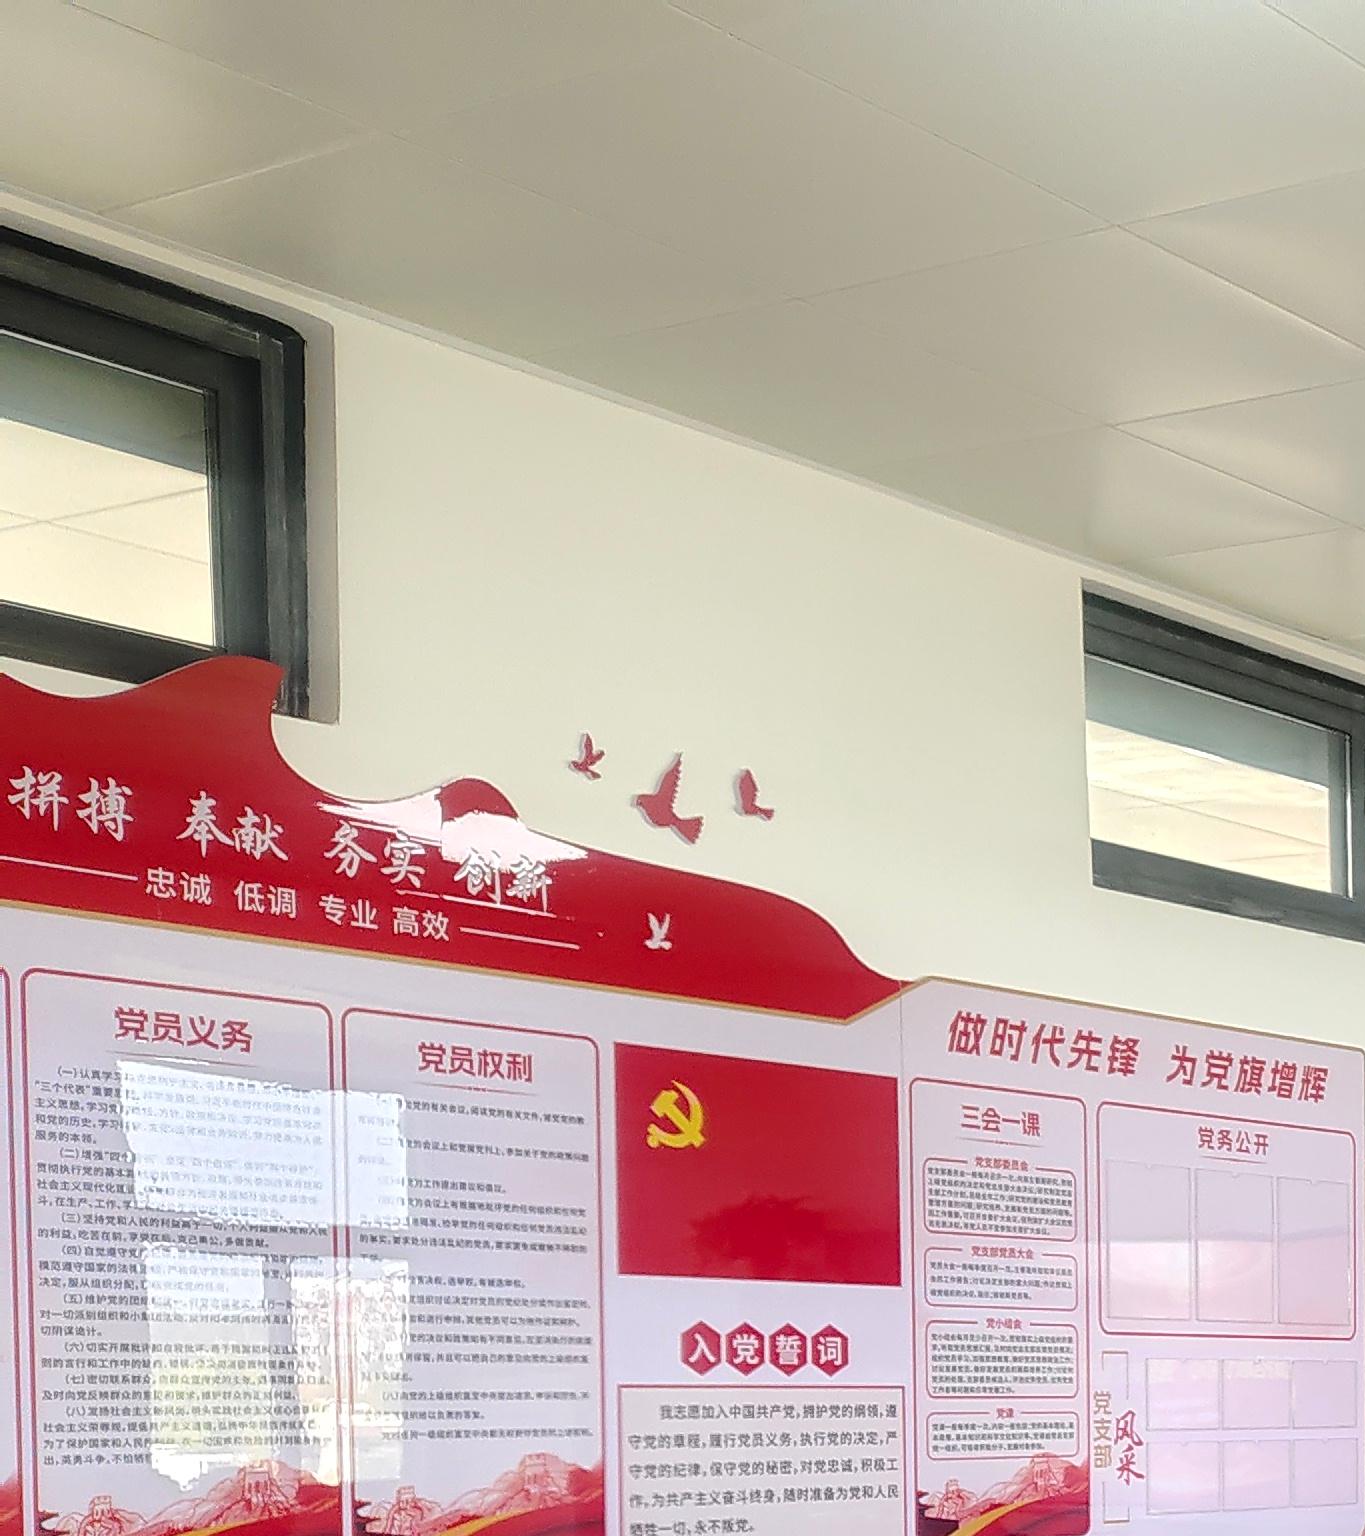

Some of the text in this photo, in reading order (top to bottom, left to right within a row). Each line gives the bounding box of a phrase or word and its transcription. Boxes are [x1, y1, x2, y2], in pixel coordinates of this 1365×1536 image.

[8, 765, 554, 912] 拼搏 奉献 务实 创新
[144, 866, 451, 943] 忠诚 低调 专业 高效
[113, 1006, 253, 1053] 党员义务
[946, 1009, 1330, 1104] 做时代先锋 为党旗增辉
[417, 1041, 534, 1083] 党员权利
[960, 1105, 1041, 1138] 三会一课
[1197, 1126, 1270, 1156] 党务公开
[687, 1332, 843, 1367] 入党誓词
[1093, 1390, 1113, 1469] 党支部
[1113, 1409, 1146, 1486] 风采
